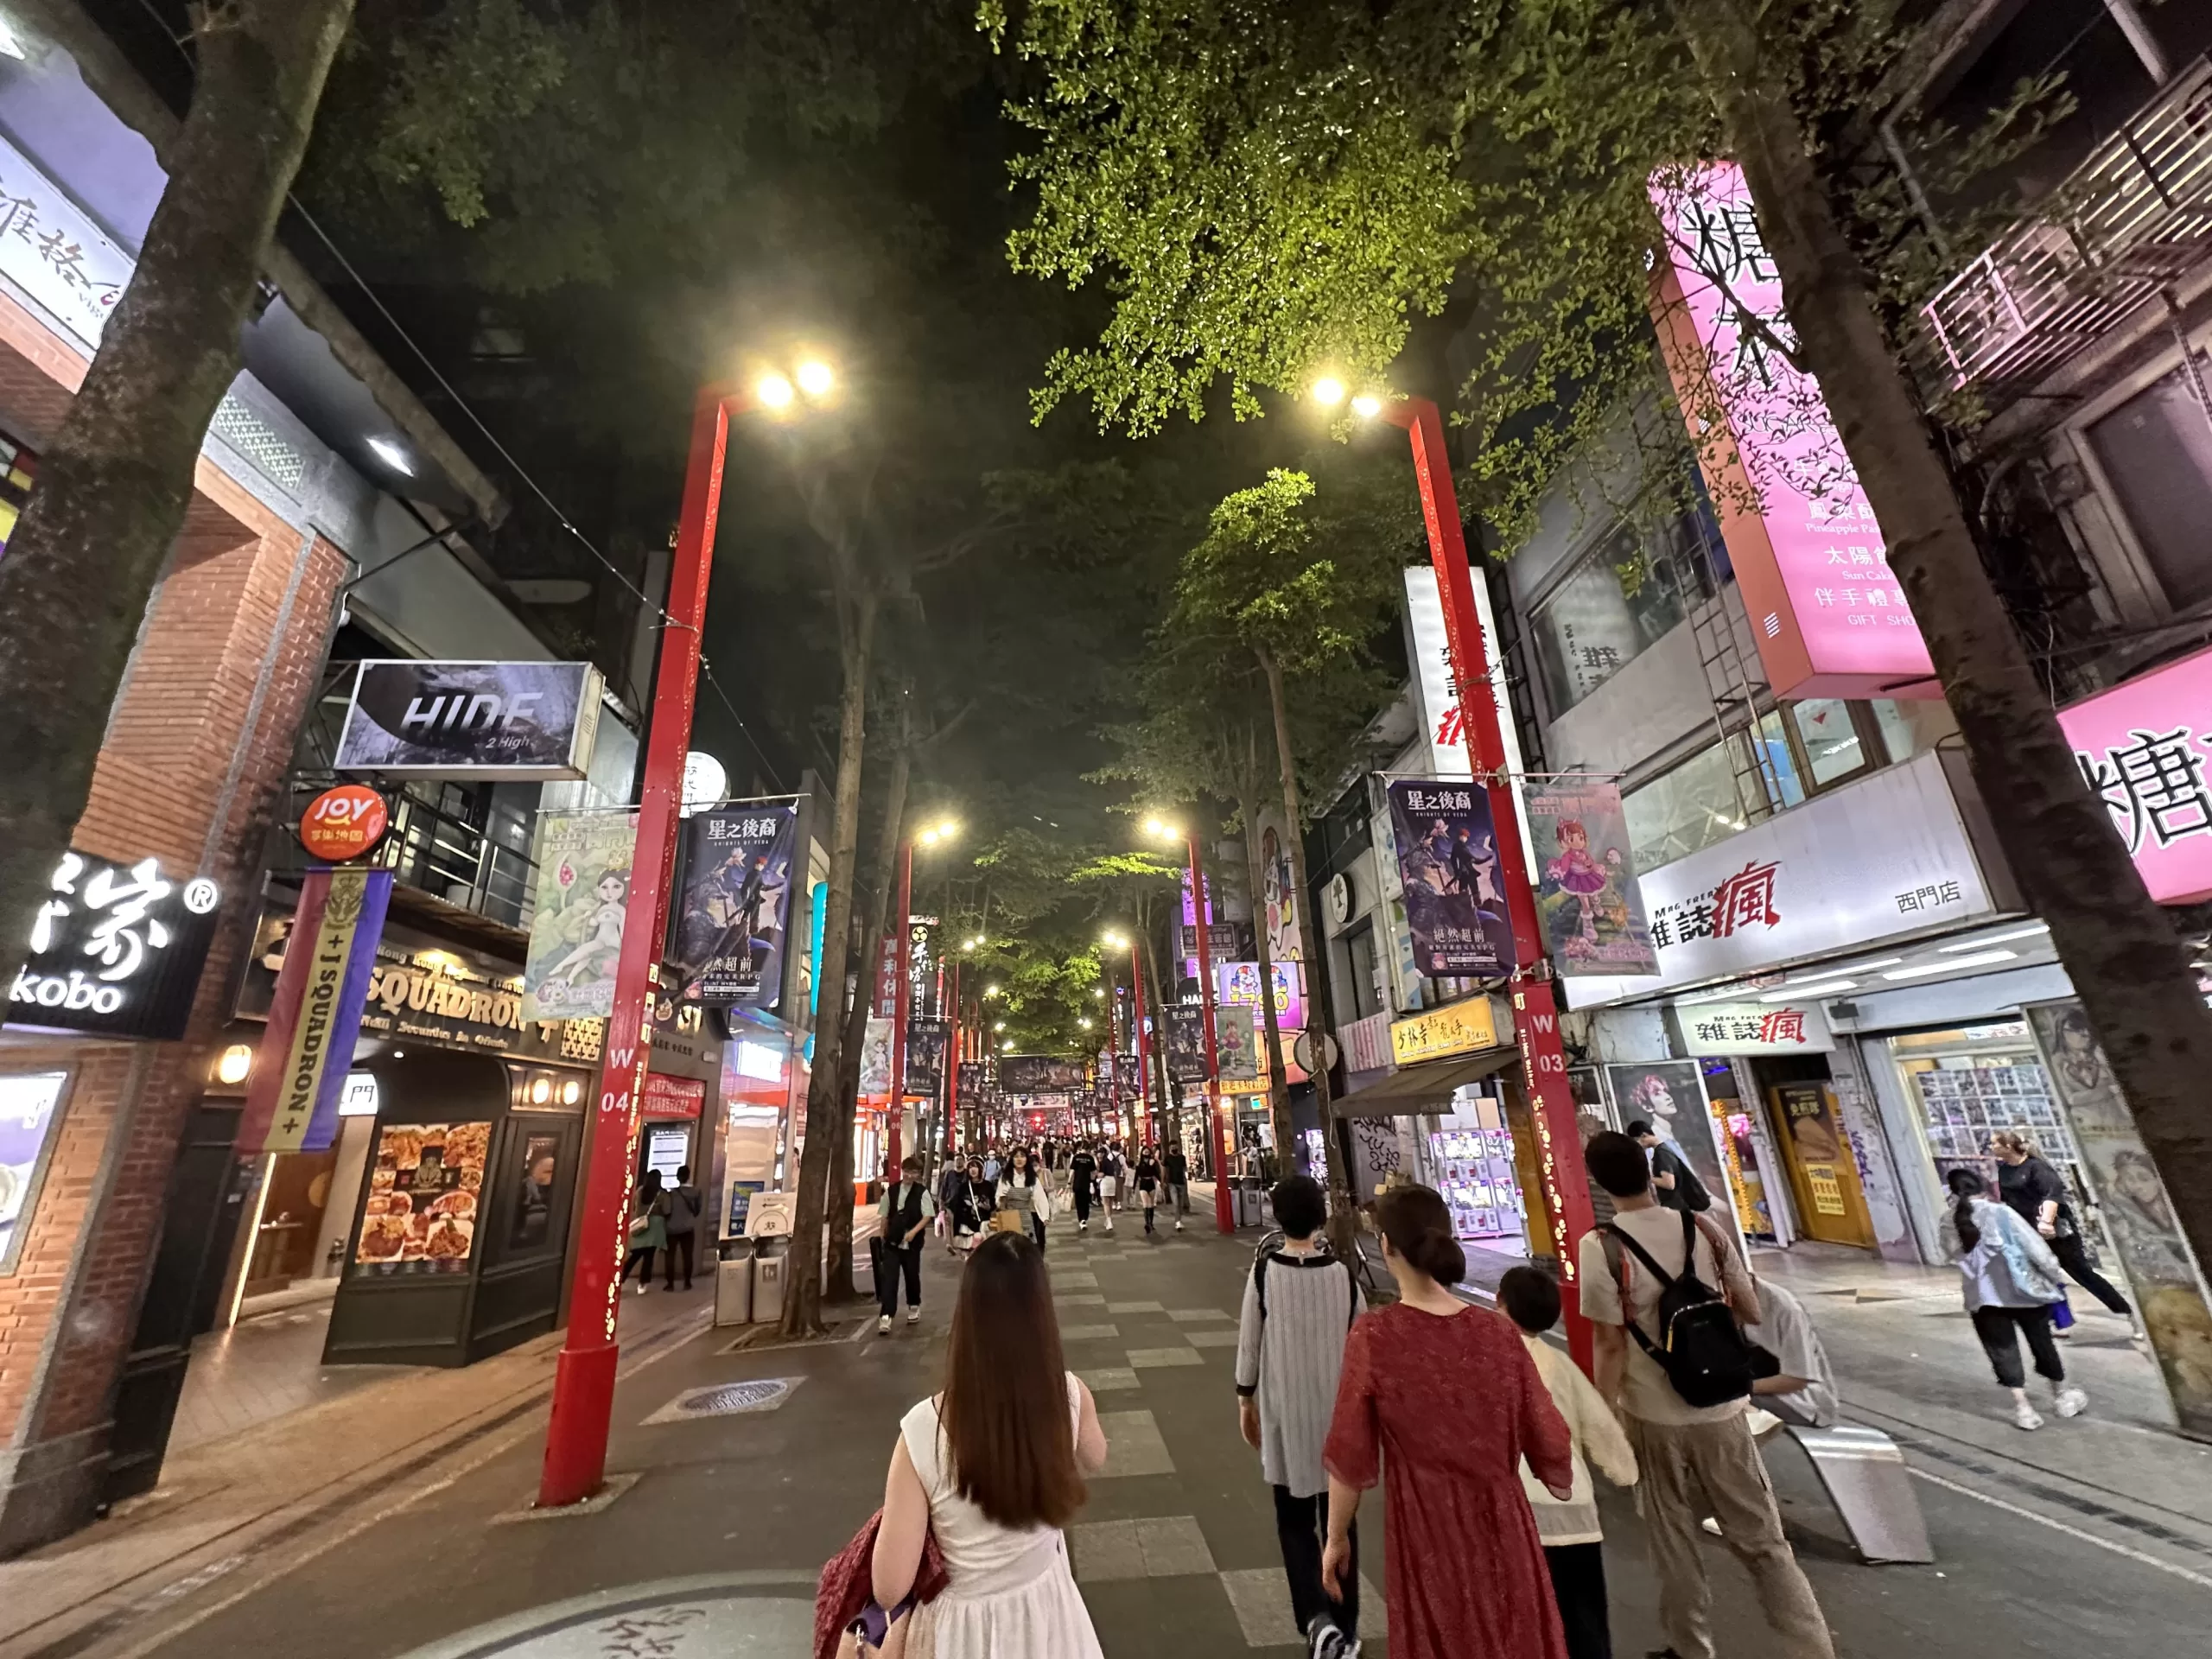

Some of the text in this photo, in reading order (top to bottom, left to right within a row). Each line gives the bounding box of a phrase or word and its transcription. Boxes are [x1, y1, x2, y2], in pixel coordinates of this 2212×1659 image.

[1805, 522, 1859, 536] Pineapple
[1841, 570, 1866, 581] Sun
[1847, 613, 1878, 626] GIFT
[485, 735, 531, 750] 2 High
[314, 798, 375, 822] JOY
[1407, 790, 1472, 810] 星之後裔
[706, 817, 777, 840] 星之後裔
[1894, 880, 1962, 914] 西門店
[376, 945, 408, 965] Hong
[9, 963, 122, 1014] kobo
[365, 966, 527, 1033] SQUADRON
[1532, 1014, 1554, 1034] W
[1694, 1007, 1808, 1045] 雜誌瘋
[288, 969, 337, 1112] SQUADRON
[610, 1047, 635, 1070] W
[1539, 1053, 1565, 1073] 03
[601, 1090, 629, 1113] 04
